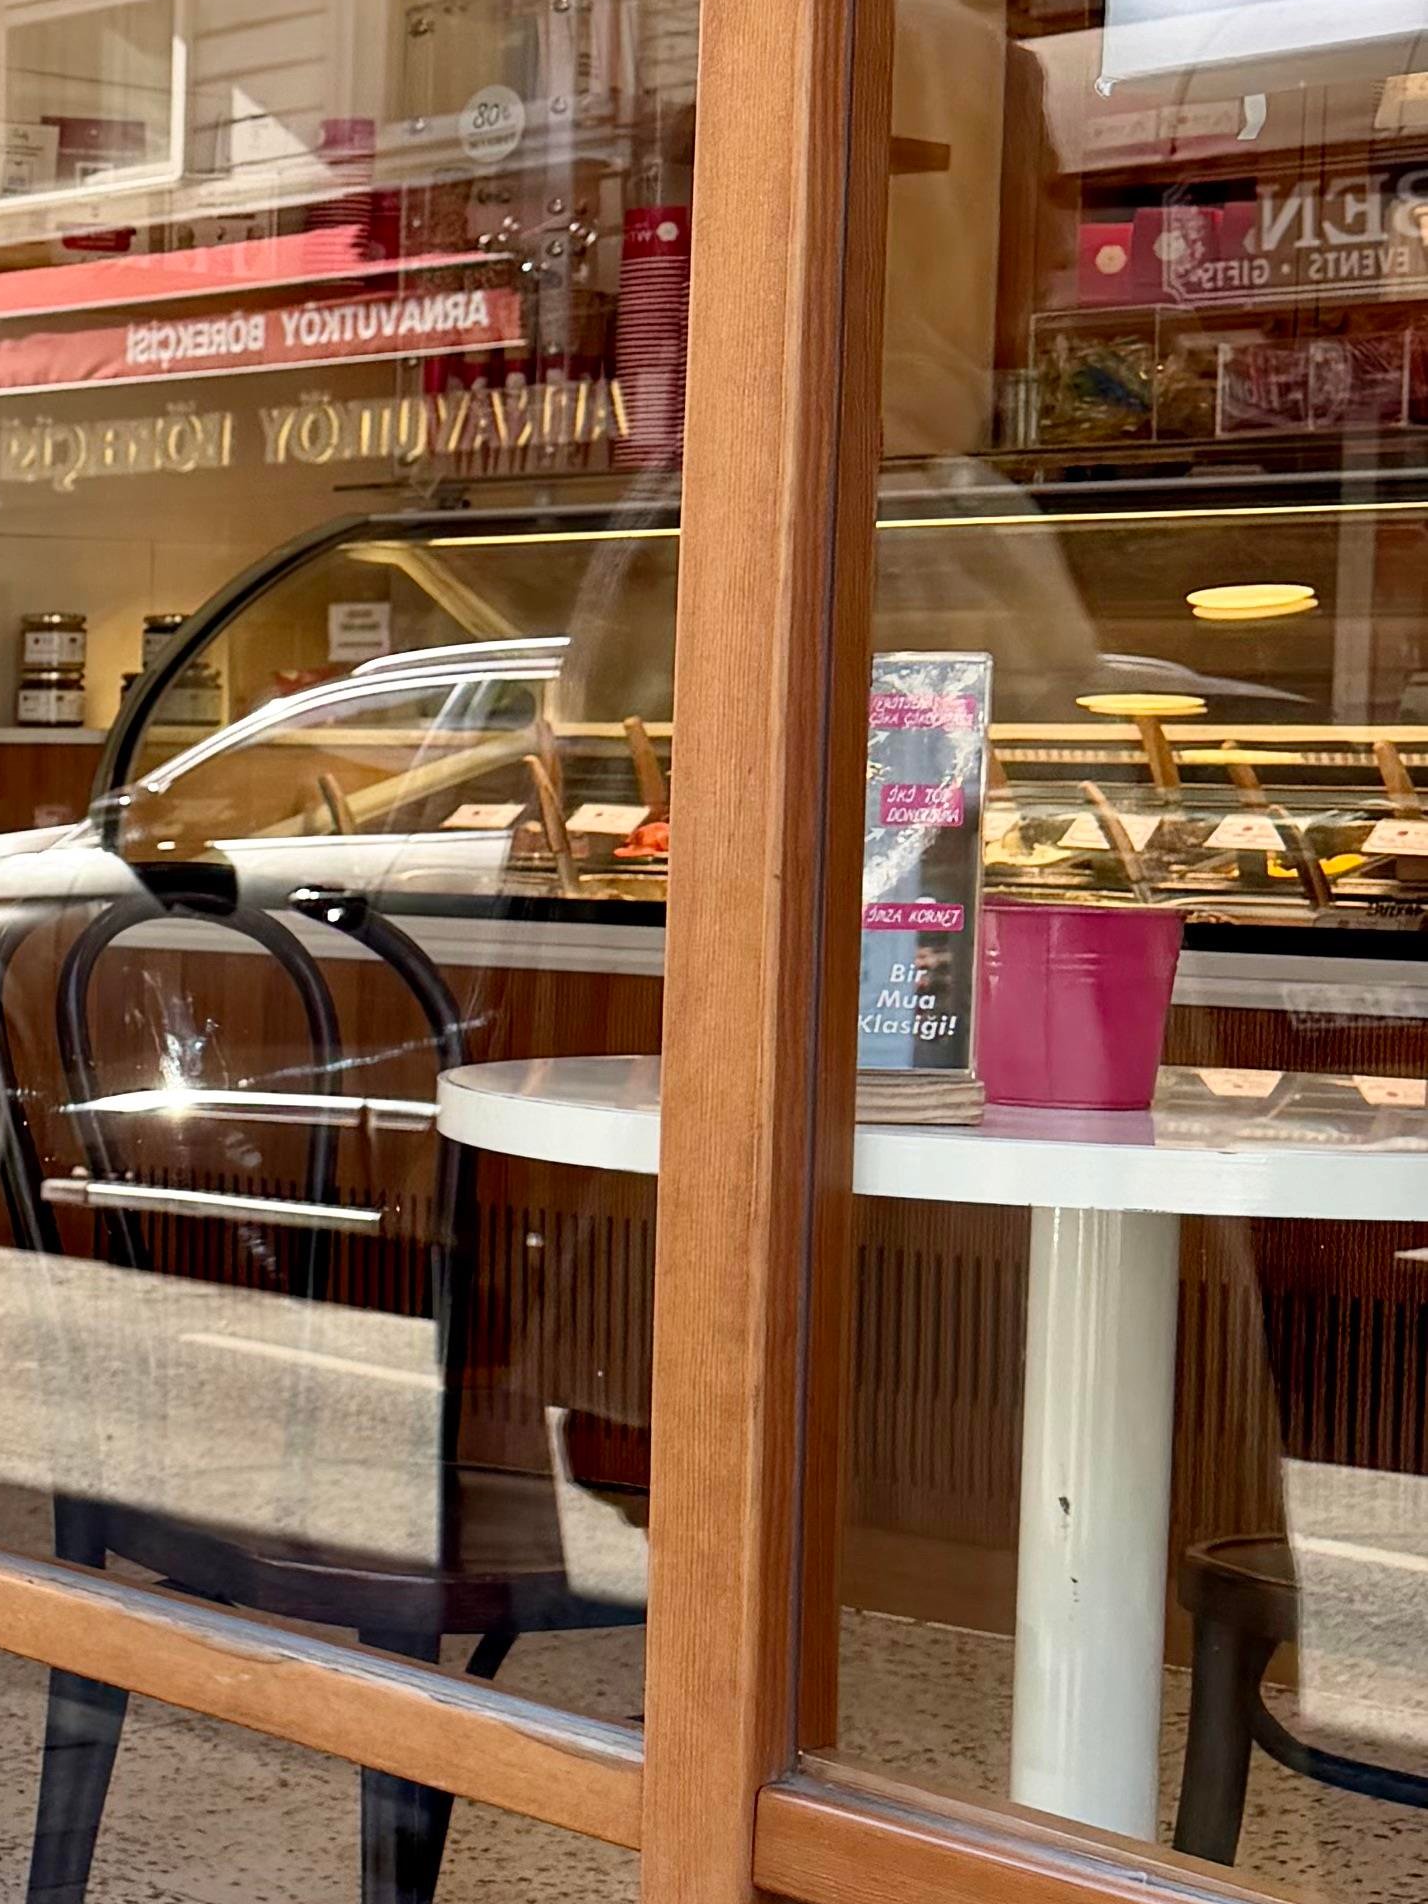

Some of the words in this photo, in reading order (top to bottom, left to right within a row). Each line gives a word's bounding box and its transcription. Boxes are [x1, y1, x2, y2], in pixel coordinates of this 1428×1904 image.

[890, 962, 928, 983] Bir
[876, 989, 936, 1010] Mua
[858, 1014, 958, 1041] Klasiği!
